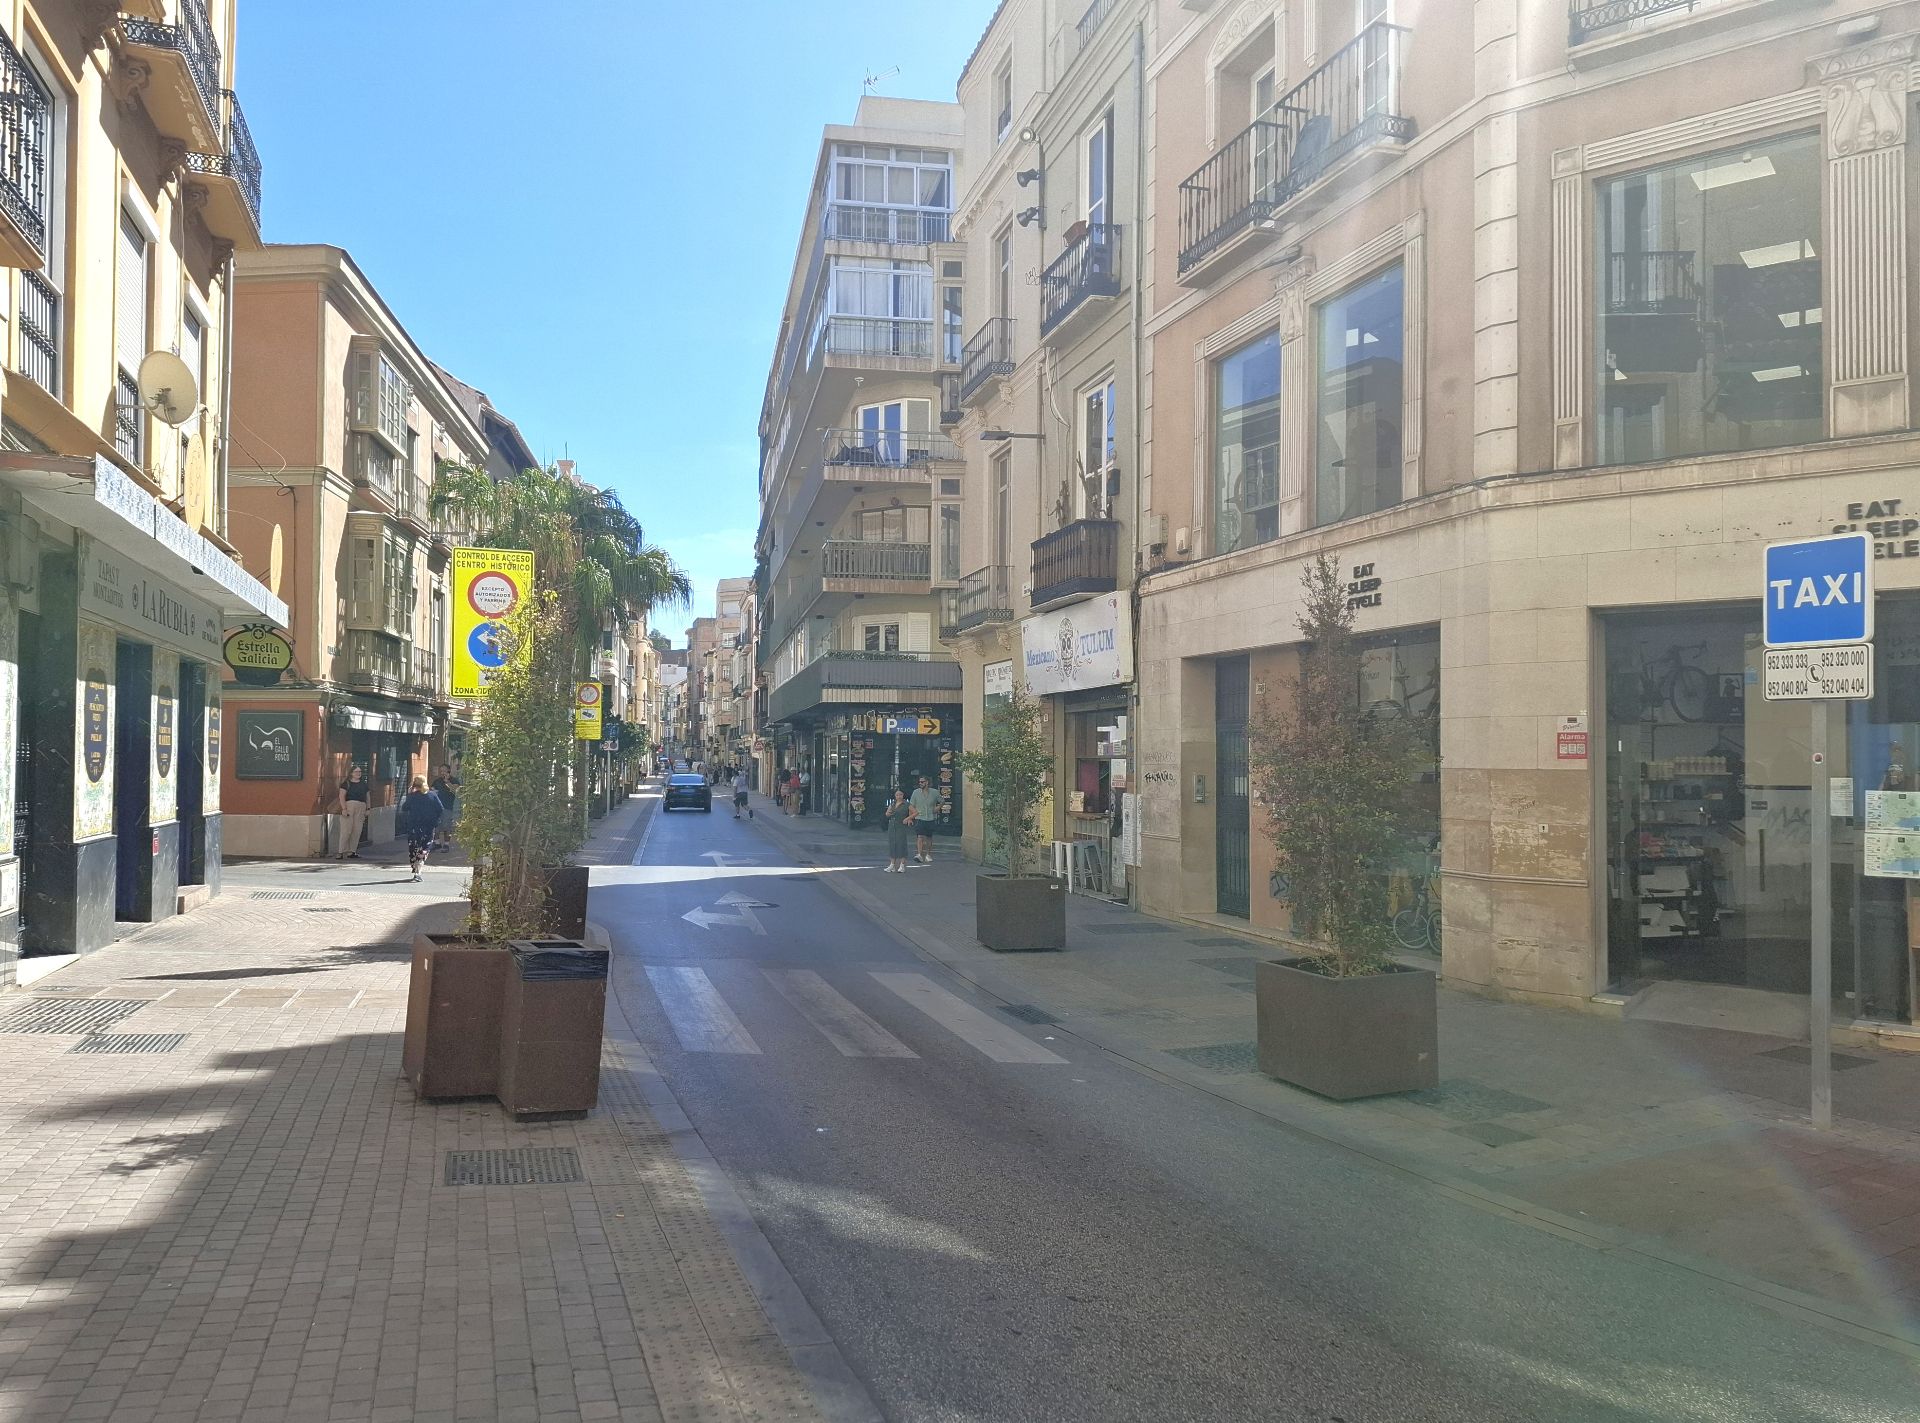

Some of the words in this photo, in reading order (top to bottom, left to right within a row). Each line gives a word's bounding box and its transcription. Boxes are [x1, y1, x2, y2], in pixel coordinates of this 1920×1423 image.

[1847, 498, 1901, 520] EAT
[456, 551, 489, 561] CONTROL
[490, 553, 500, 561] DE
[501, 554, 530, 563] ACCESO
[1874, 539, 1920, 560] CLE
[456, 560, 486, 569] CENTRO
[1353, 562, 1375, 579] EAT
[1347, 577, 1382, 595] SLEEP
[1769, 571, 1862, 610] TAXI
[141, 580, 158, 622] LA
[158, 589, 189, 636] RUBIA
[236, 640, 280, 654] Estrella
[1080, 628, 1114, 657] TULUM
[238, 652, 278, 665] Galicia
[1026, 650, 1055, 667] Mexicano
[1768, 656, 1780, 670] 952
[1781, 655, 1794, 669] 333
[1795, 653, 1808, 668] 333
[1821, 652, 1834, 668] 952
[1835, 651, 1849, 667] 320
[1850, 650, 1865, 666] 000
[1768, 682, 1780, 696] 952
[1781, 681, 1794, 695] 040
[1795, 680, 1808, 694] 804
[1821, 679, 1834, 694] 952
[1835, 678, 1849, 694] 040
[1850, 678, 1865, 693] 404
[886, 718, 898, 733] P
[274, 736, 281, 745] EL
[274, 745, 289, 754] GALLO
